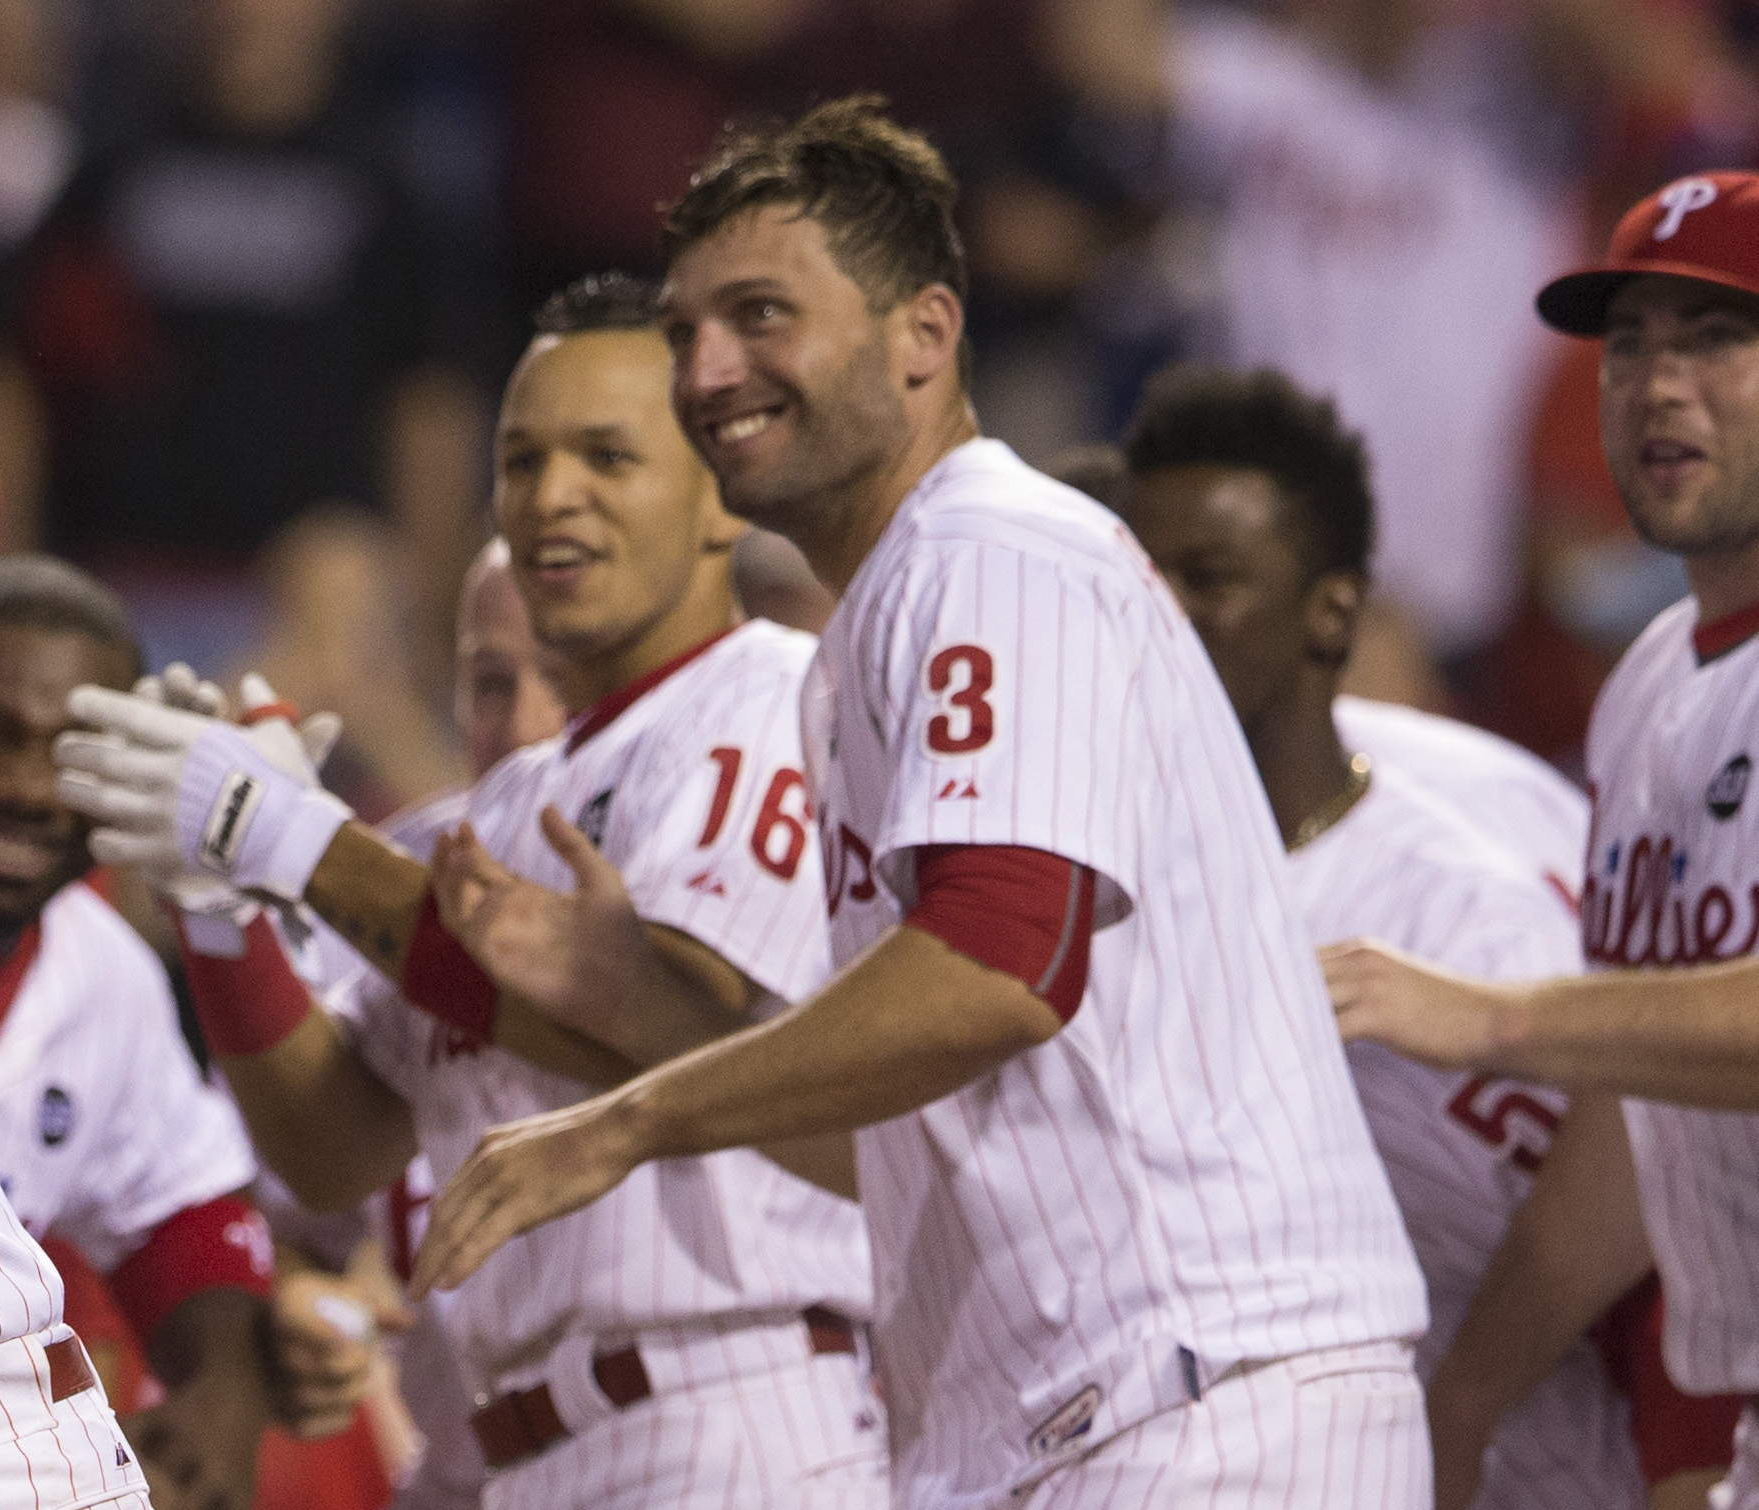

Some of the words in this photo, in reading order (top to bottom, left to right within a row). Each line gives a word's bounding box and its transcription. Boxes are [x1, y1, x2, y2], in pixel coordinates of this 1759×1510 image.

[1654, 176, 1717, 242] P
[928, 645, 993, 754] 3
[697, 747, 813, 882] 16
